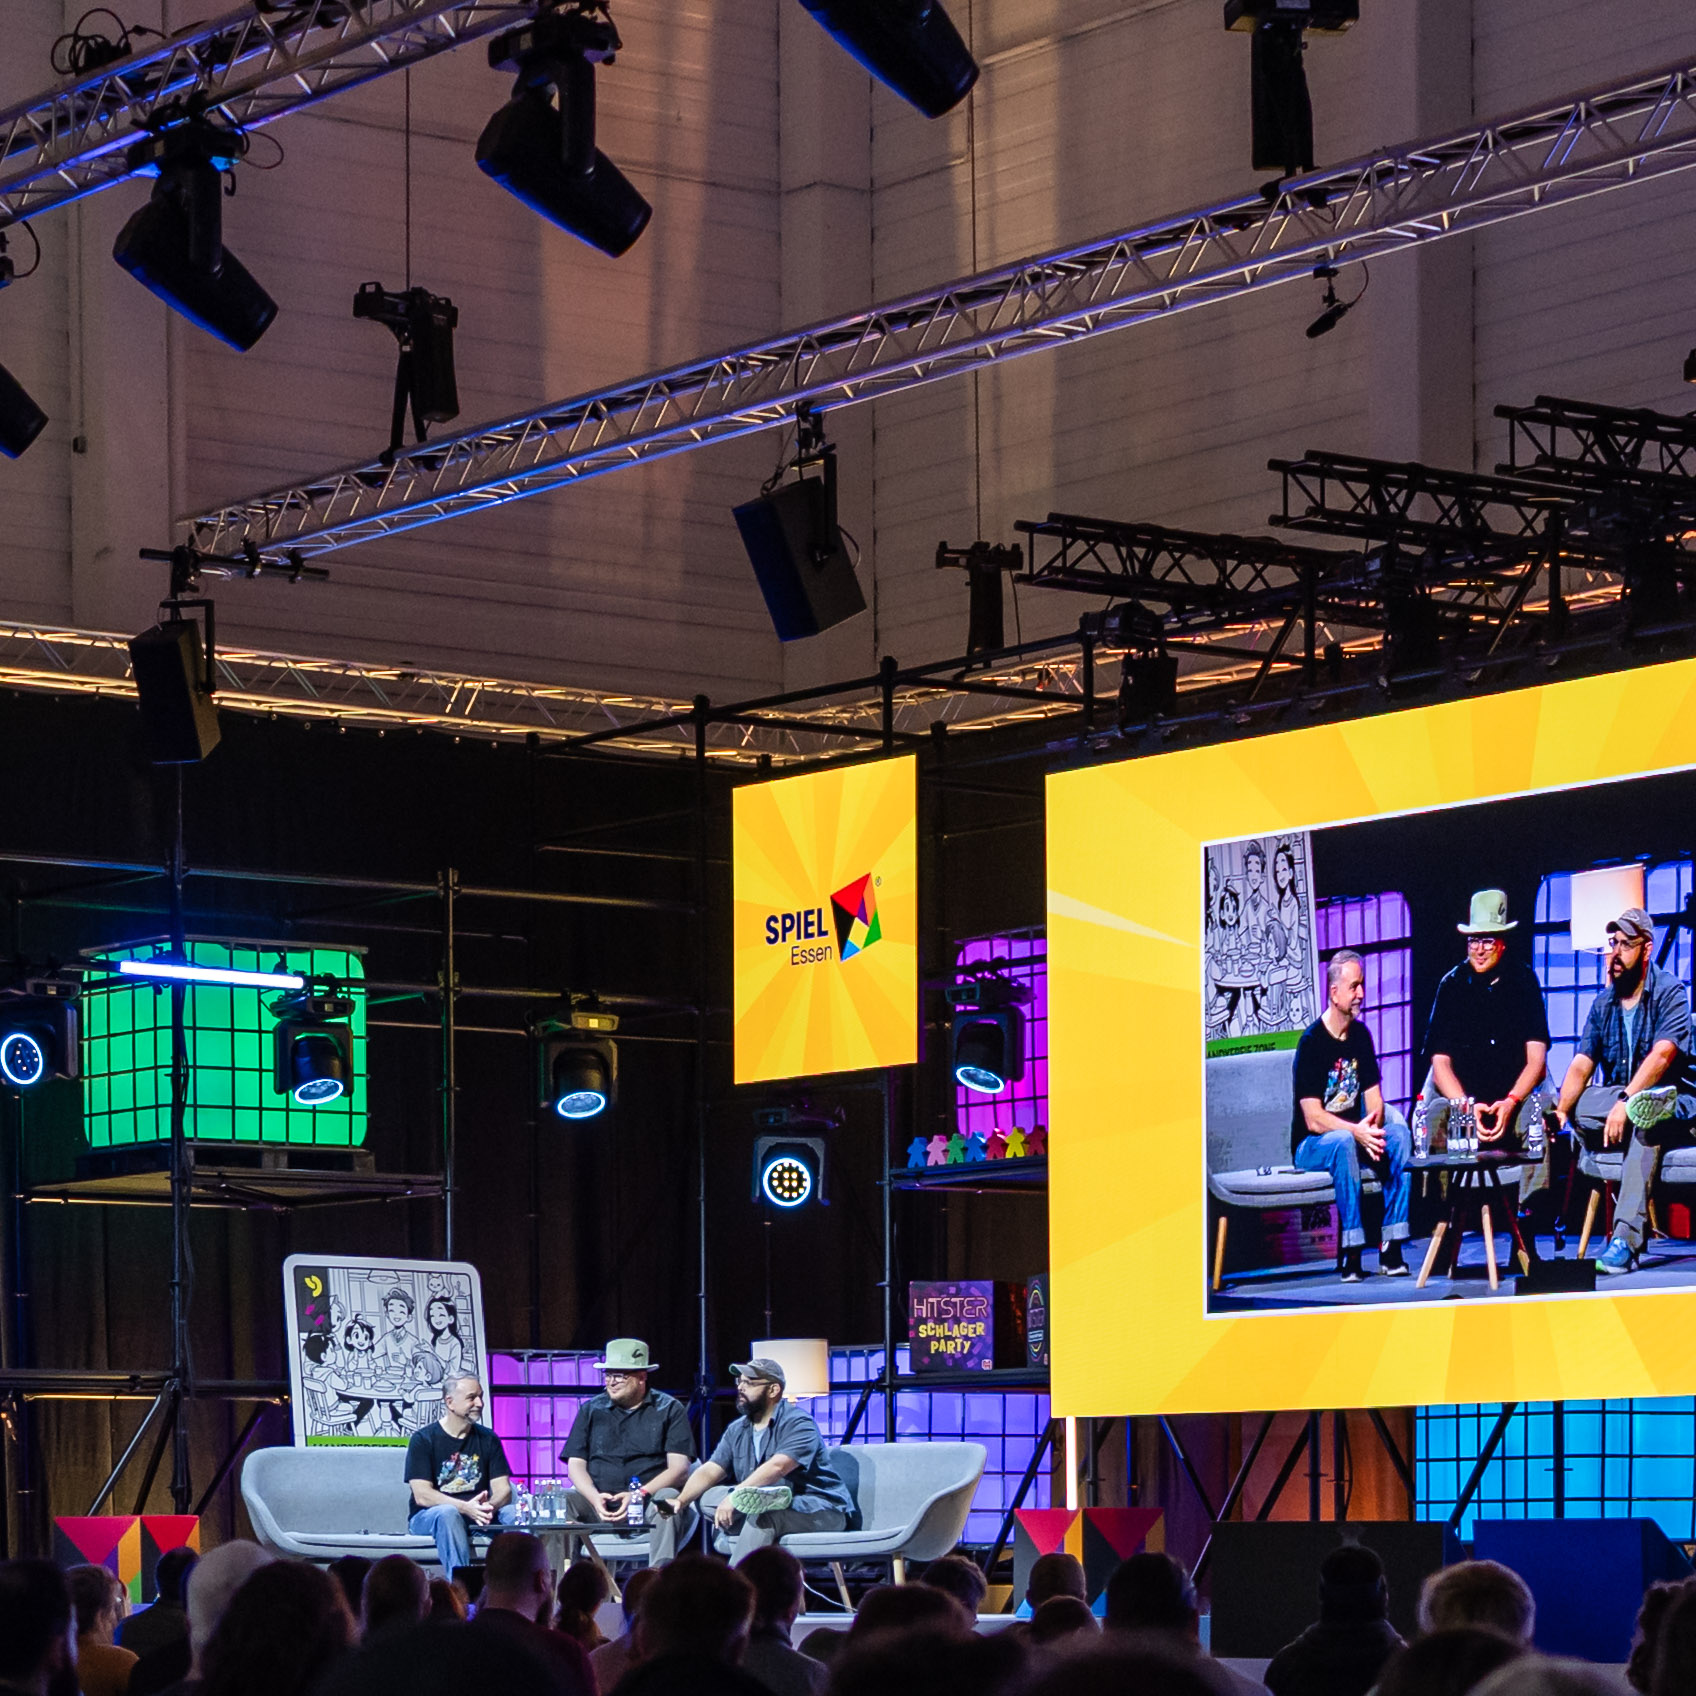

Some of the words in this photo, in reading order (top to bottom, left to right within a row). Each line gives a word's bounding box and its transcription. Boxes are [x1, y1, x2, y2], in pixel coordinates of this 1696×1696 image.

[765, 907, 829, 945] SPIEL
[791, 945, 832, 966] Essen
[913, 1297, 988, 1318] HITSTER
[918, 1322, 985, 1338] SCHLAGER
[930, 1338, 971, 1354] PARTY
